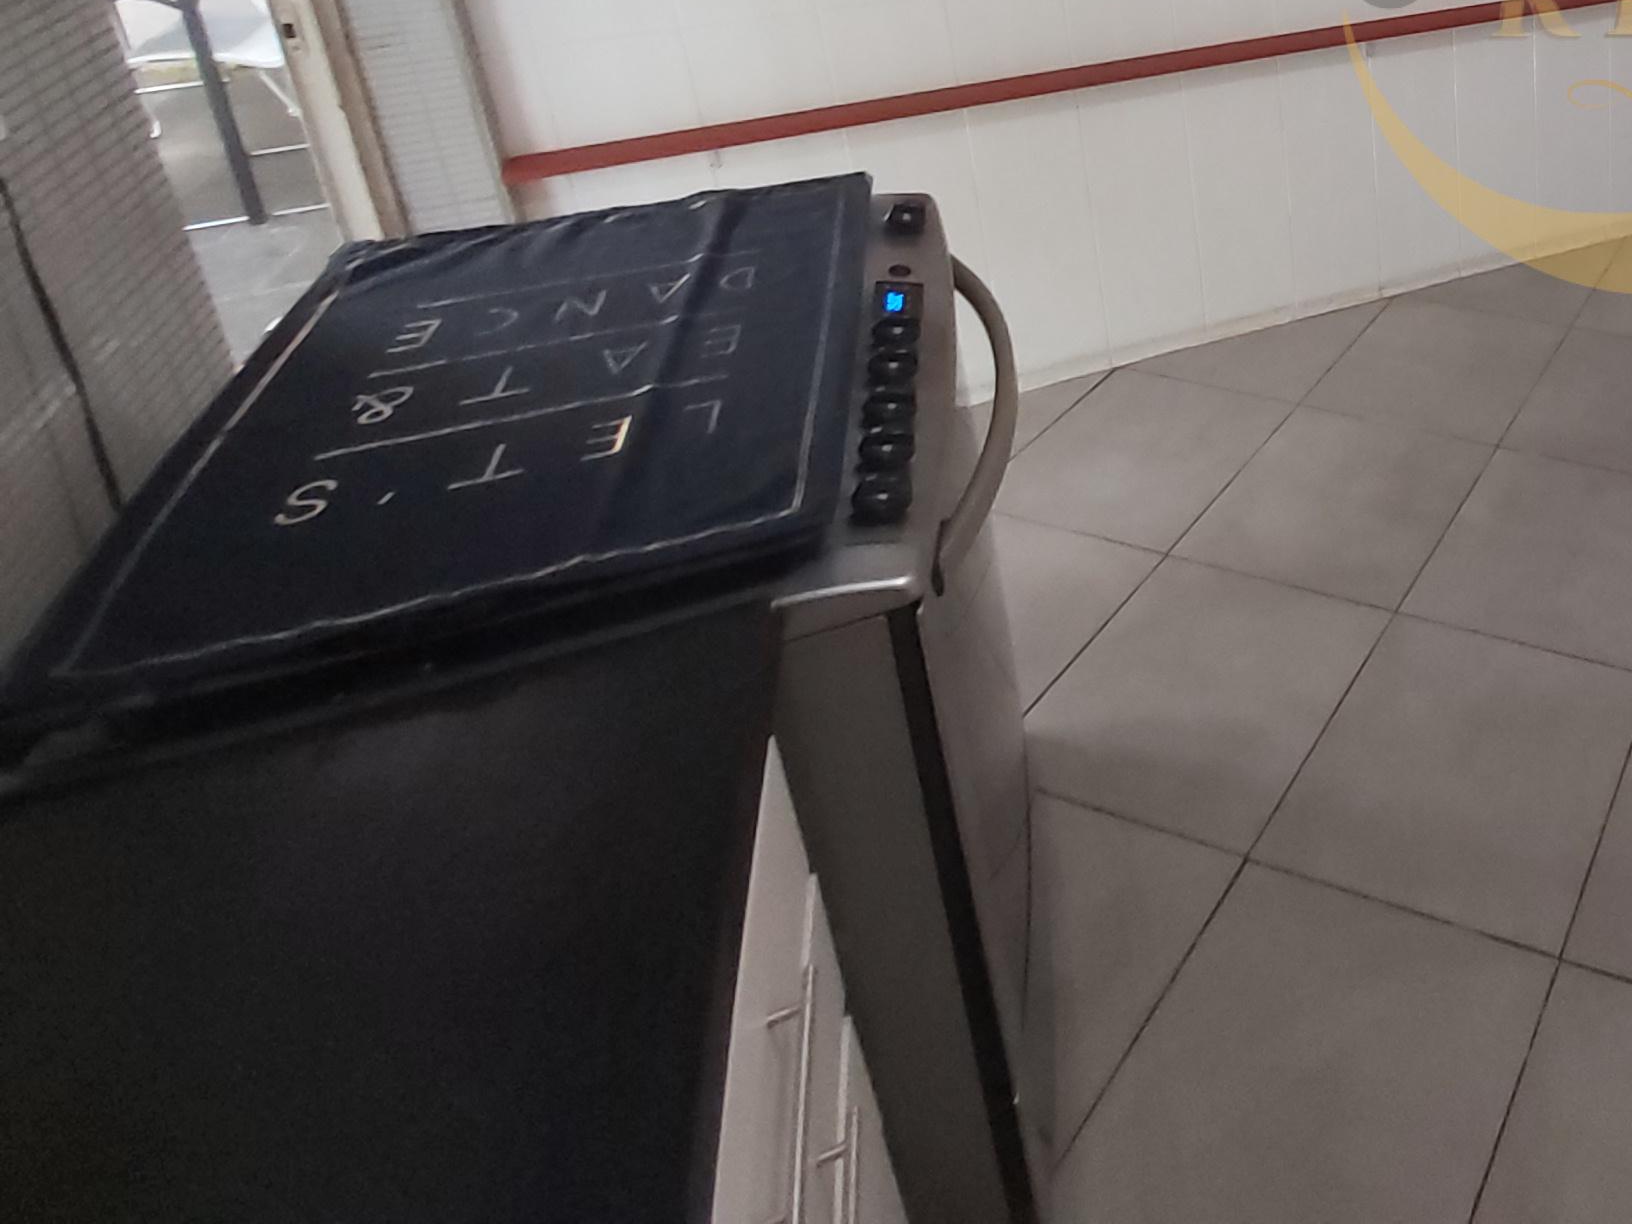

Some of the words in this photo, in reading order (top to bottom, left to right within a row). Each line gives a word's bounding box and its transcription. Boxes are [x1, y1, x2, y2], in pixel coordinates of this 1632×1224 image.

[390, 266, 755, 354] DANCE
[352, 385, 414, 426] &
[460, 322, 741, 406] EAT
[274, 401, 722, 526] LET'S
